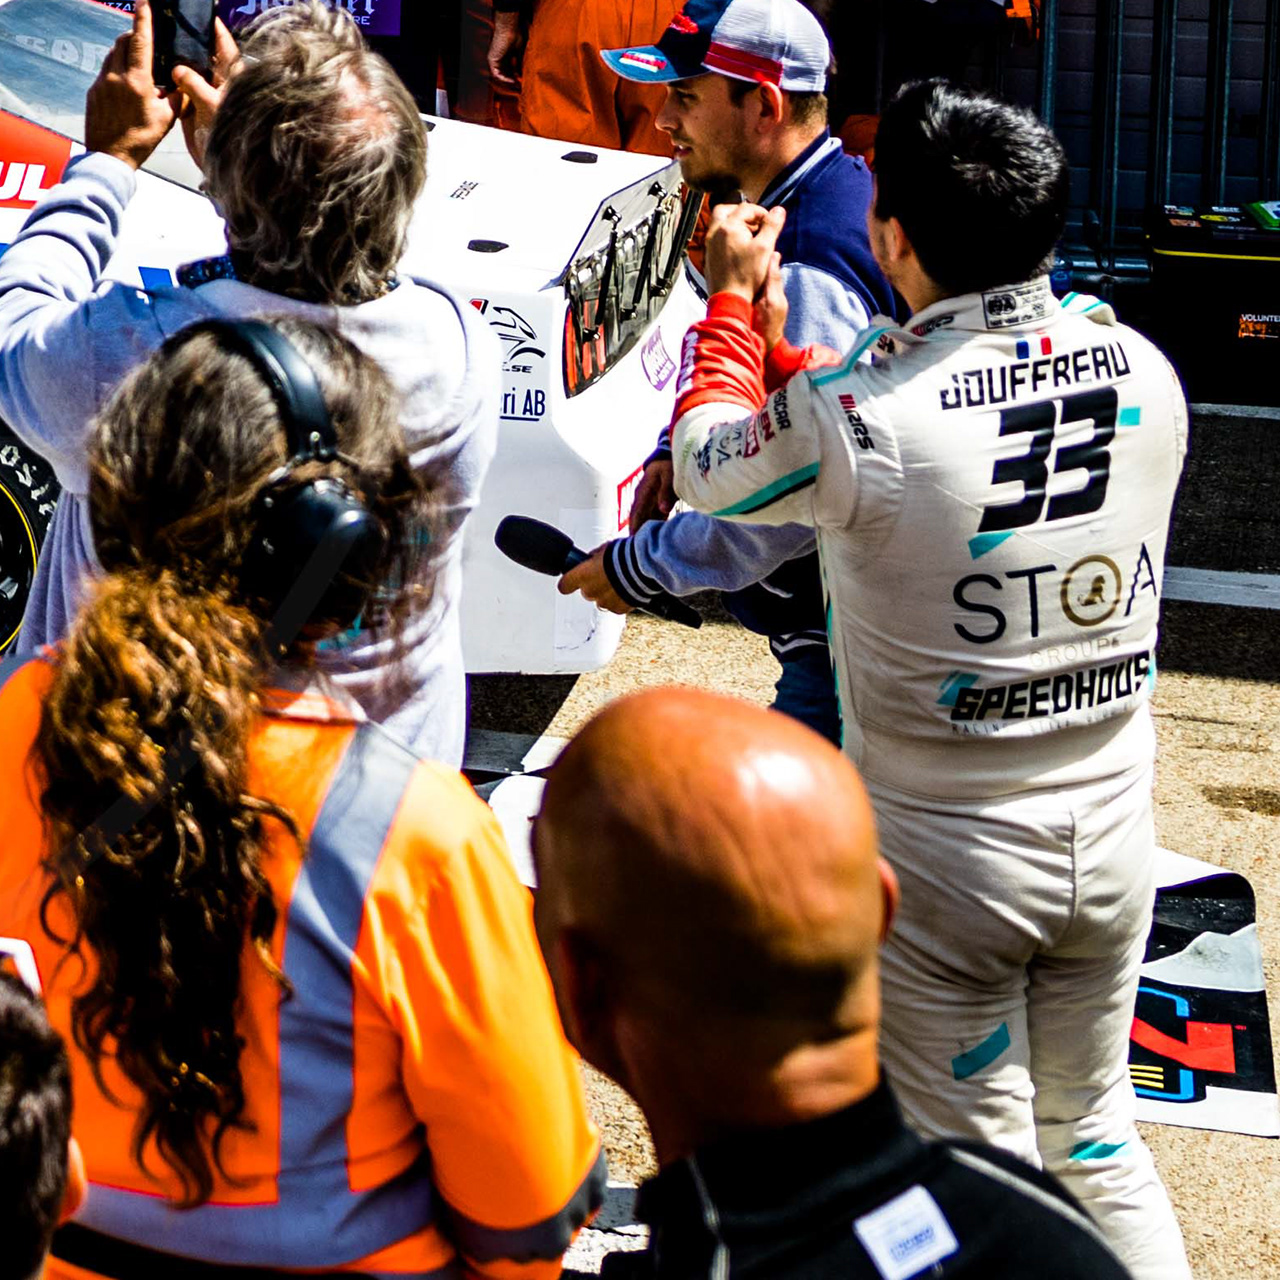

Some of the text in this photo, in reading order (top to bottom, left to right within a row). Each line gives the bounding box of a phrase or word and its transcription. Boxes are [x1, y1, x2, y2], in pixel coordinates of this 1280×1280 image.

[522, 389, 546, 417] AB
[940, 340, 1132, 411] JOUFFREAU
[978, 386, 1121, 532] 33
[950, 649, 1152, 722] SPEEDHOUS
